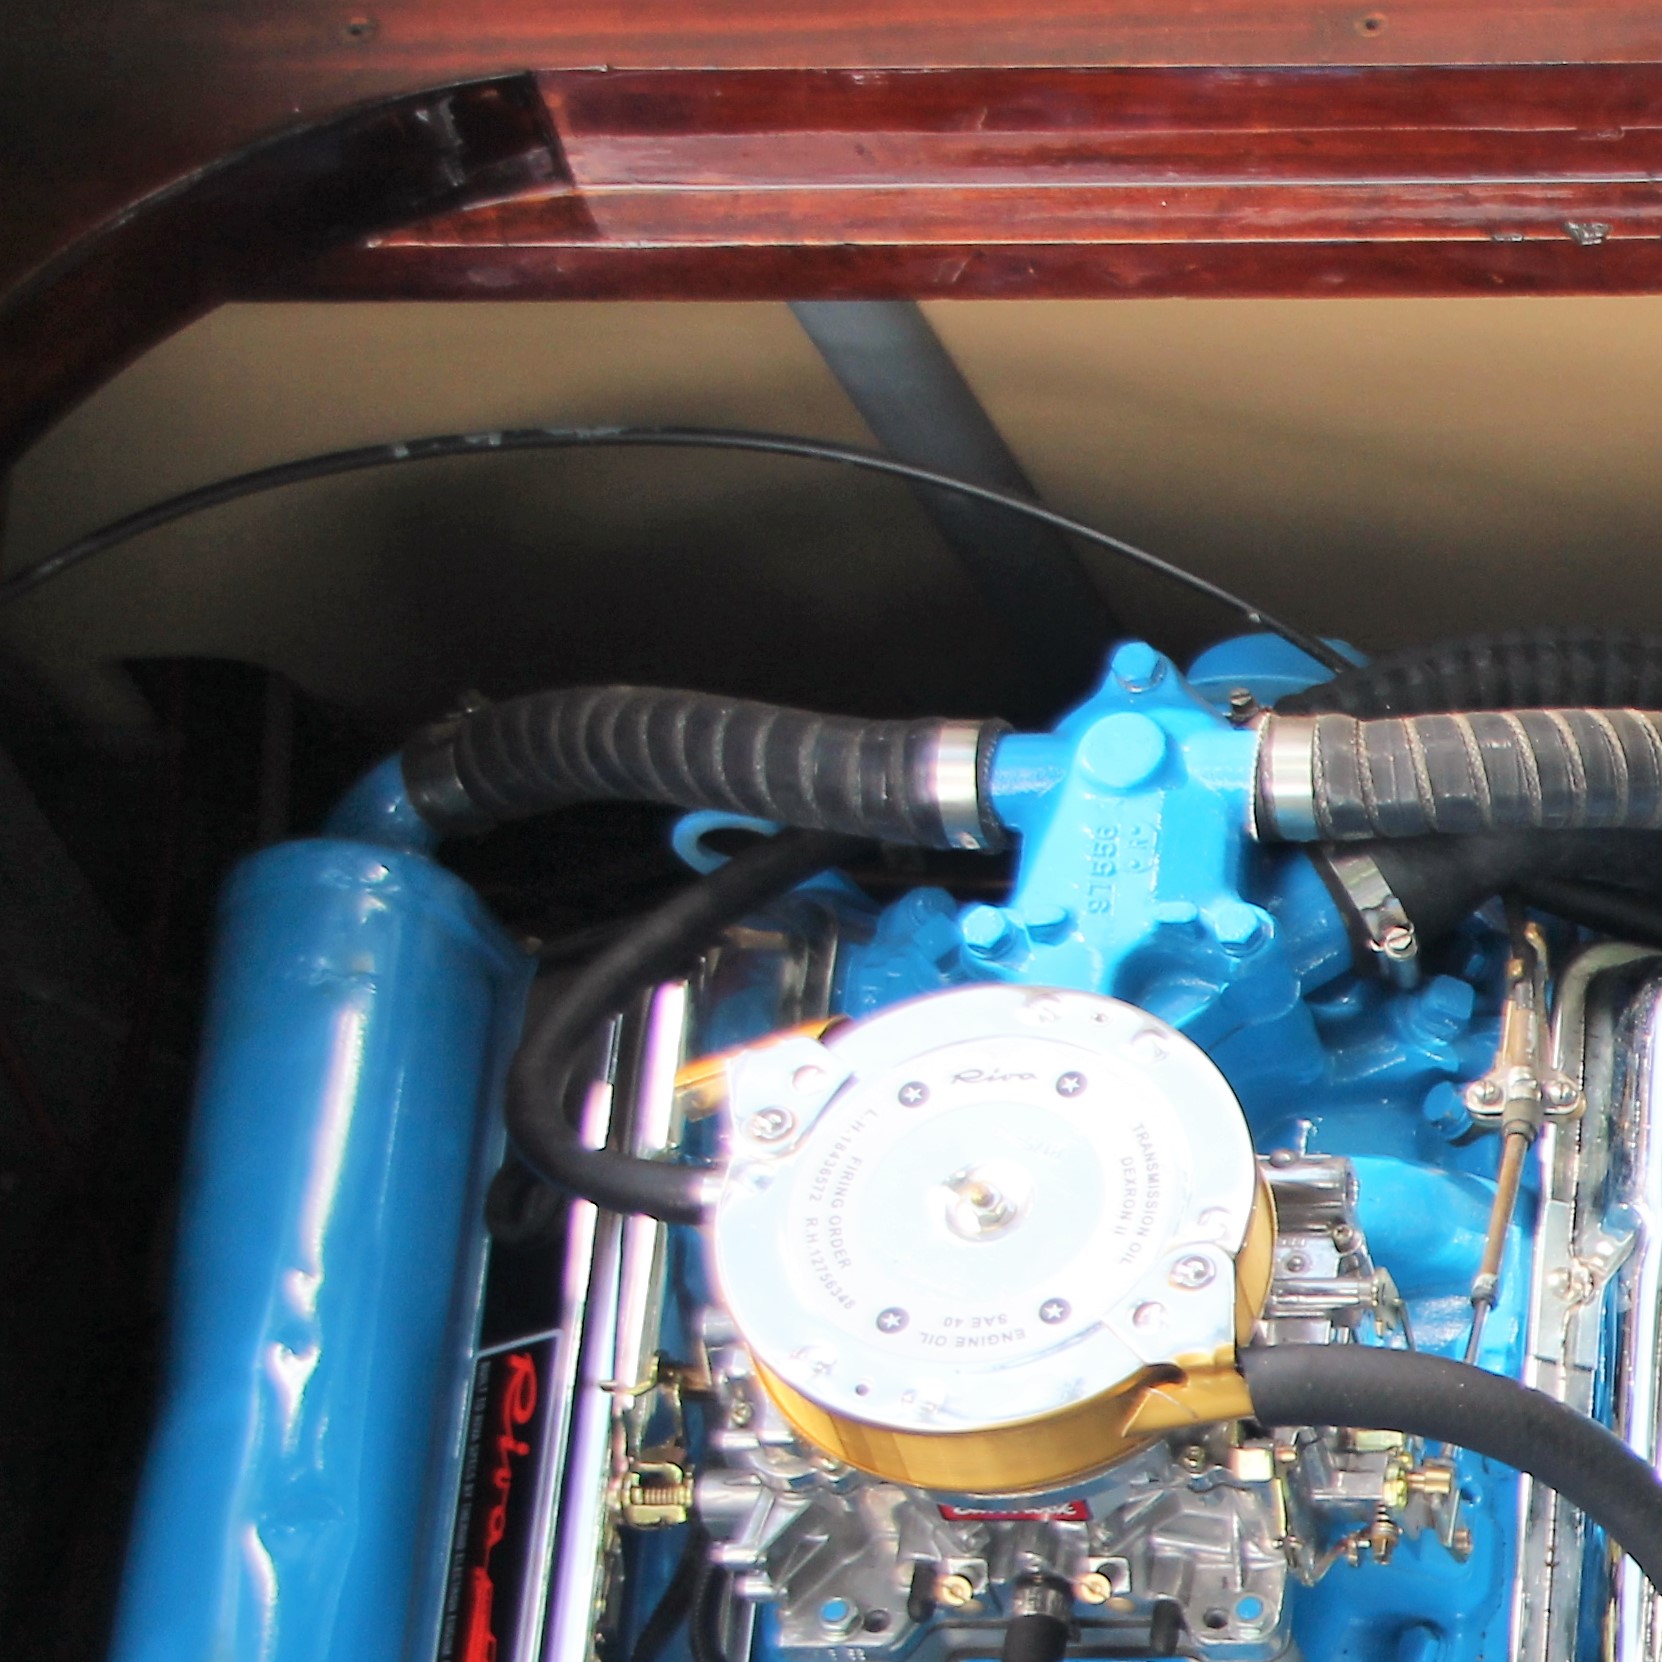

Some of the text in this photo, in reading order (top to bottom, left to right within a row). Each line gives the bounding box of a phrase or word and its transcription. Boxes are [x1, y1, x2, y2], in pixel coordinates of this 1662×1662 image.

[950, 1067, 1038, 1085] Riva
[828, 1155, 863, 1270] FIRING ORDER
[1120, 1156, 1137, 1221] DEXRON
[1120, 1122, 1160, 1264] TRANSMISSION OIL
[919, 1328, 1026, 1348] ENGINE OIL
[943, 1313, 1008, 1328] SAE 40
[486, 1352, 538, 1549] Riva
